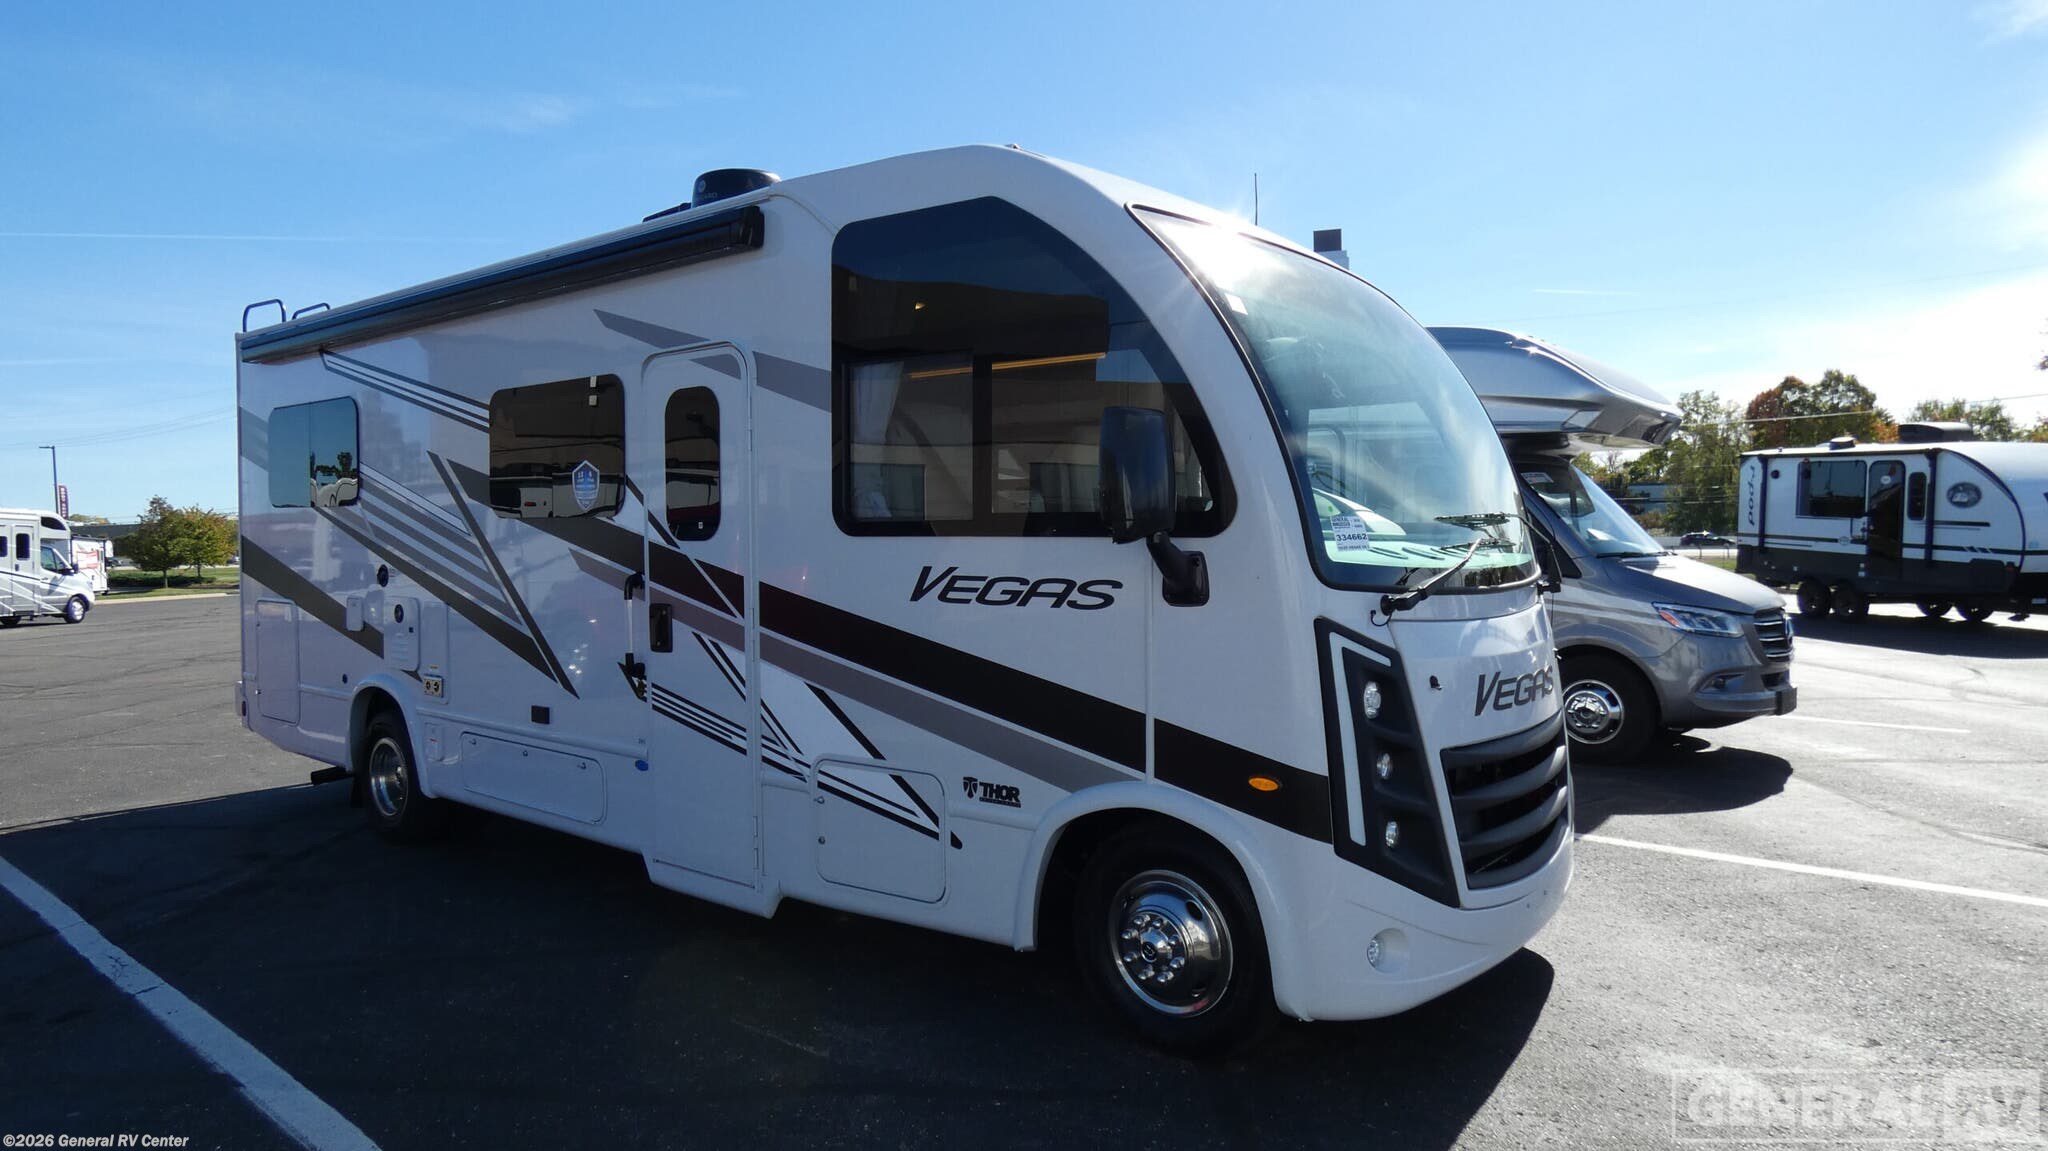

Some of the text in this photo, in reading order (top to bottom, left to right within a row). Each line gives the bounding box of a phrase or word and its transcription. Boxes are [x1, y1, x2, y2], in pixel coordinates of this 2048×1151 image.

[1336, 533, 1368, 542] 334662
[909, 566, 1124, 611] VEGAS
[1475, 665, 1553, 717] VEGAS
[979, 781, 1021, 803] THOR
